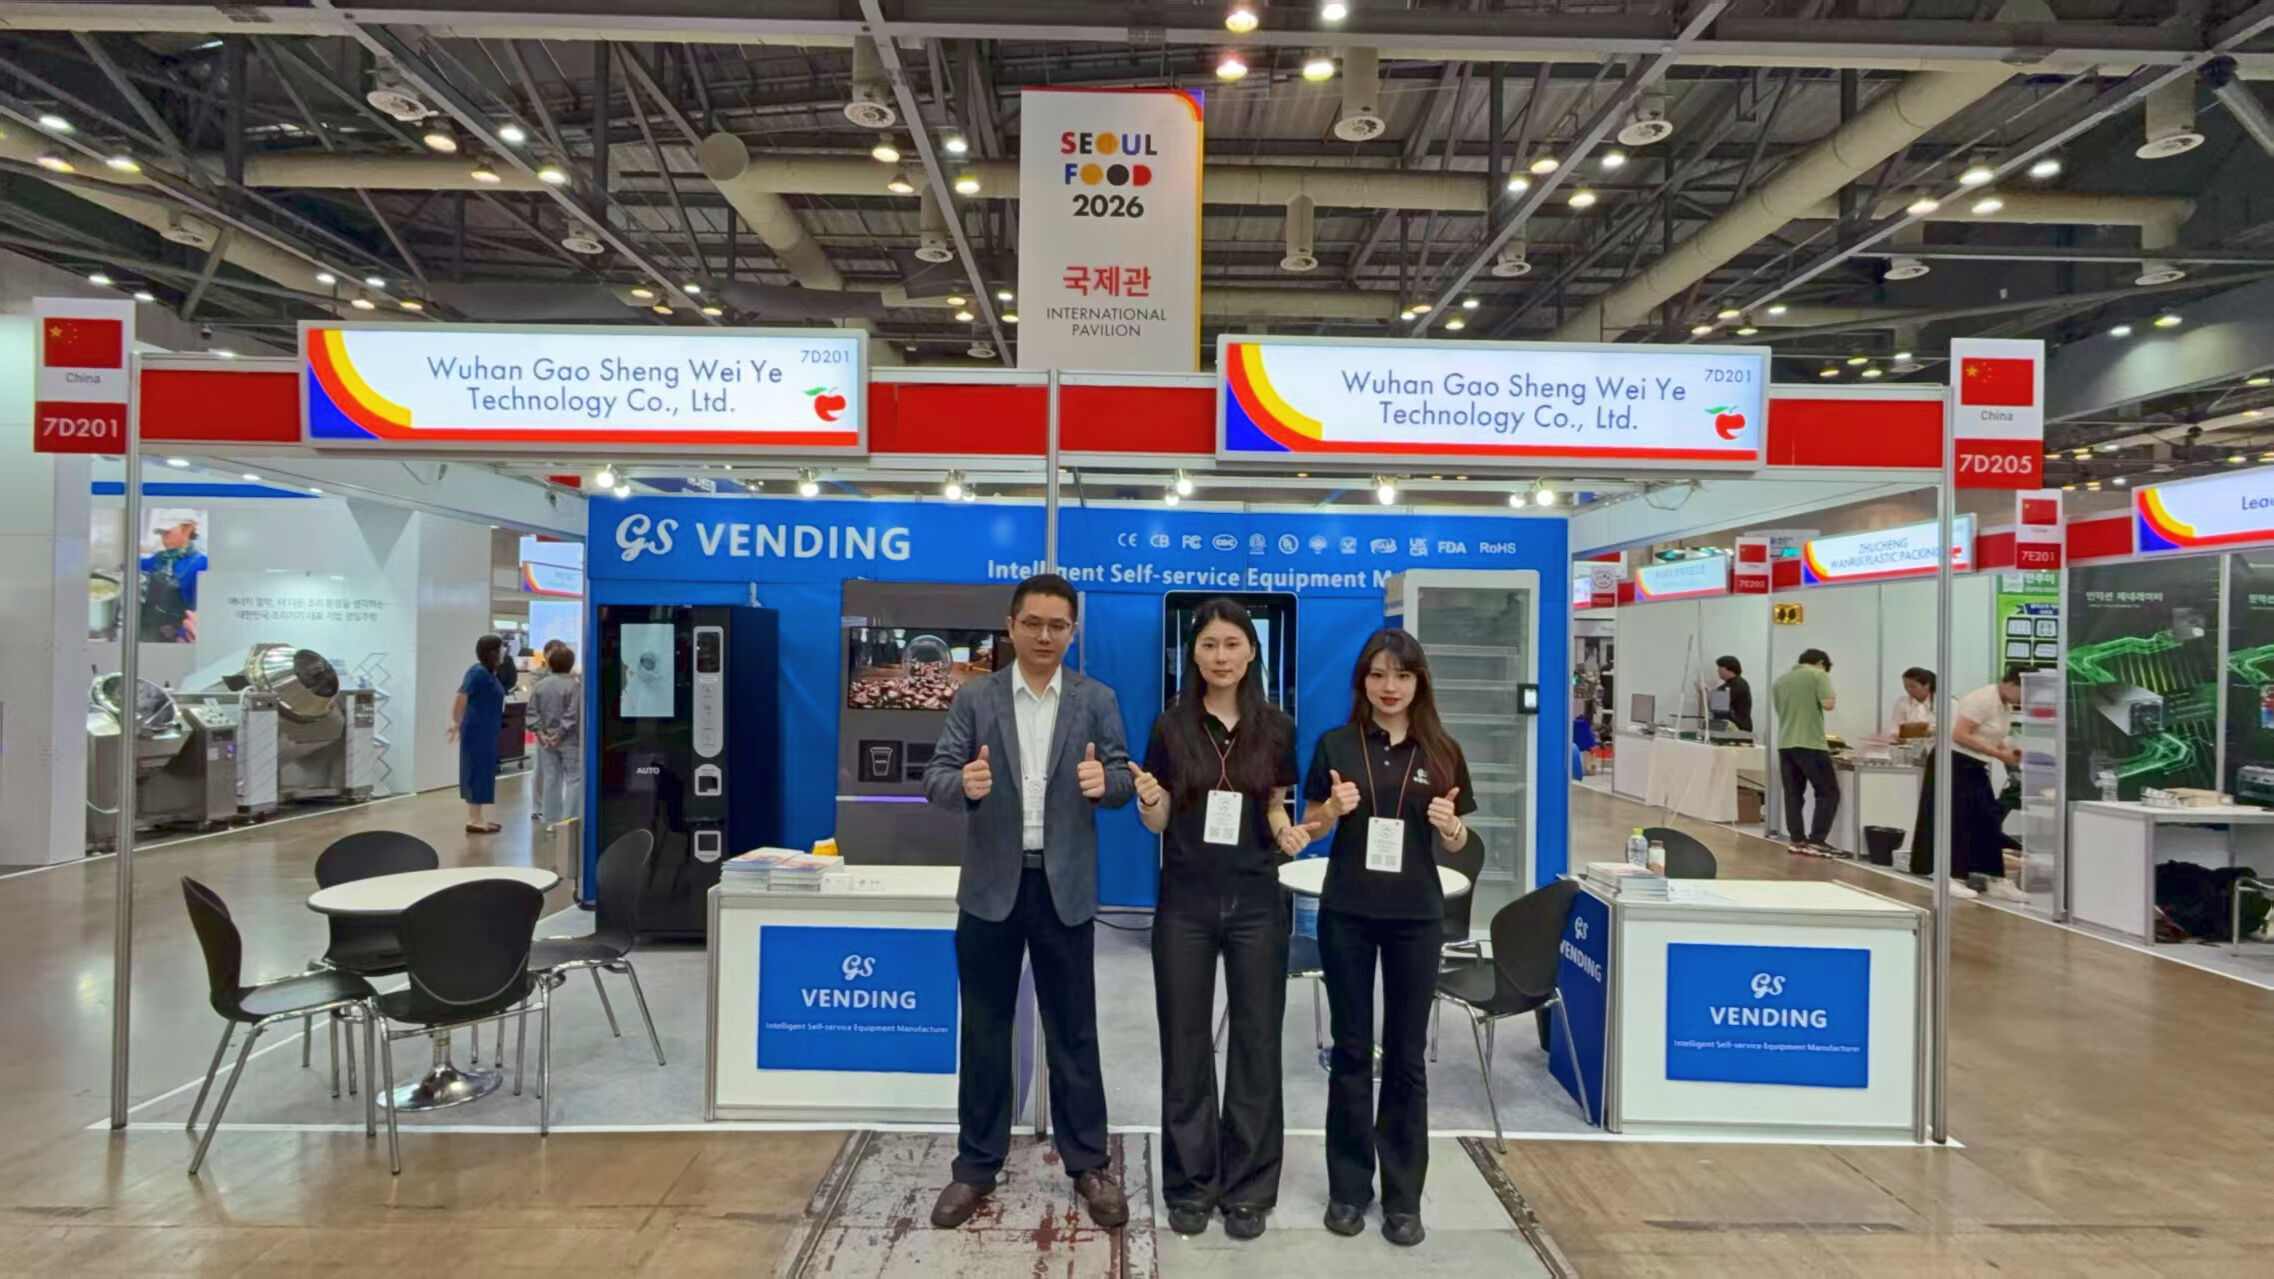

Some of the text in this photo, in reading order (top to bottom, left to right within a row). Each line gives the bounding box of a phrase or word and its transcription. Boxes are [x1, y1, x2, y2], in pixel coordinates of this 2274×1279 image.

[1060, 132, 1158, 156] SEOUL
[1064, 163, 1152, 186] FOOD
[1072, 194, 1144, 218] 2026
[1062, 266, 1151, 297] 국제관
[1046, 307, 1167, 321] INTERNATIONAL
[1071, 324, 1141, 337] PAVILION
[800, 349, 851, 364] 7D201
[64, 372, 102, 384] China
[426, 356, 783, 387] Wuhan Gao Sheng Wei Ye
[1704, 368, 1753, 384] 7D201
[1341, 370, 1687, 405] Wuhan Gao Sheng Wei Ye
[467, 387, 737, 417] Technology Co., Ltd.
[1378, 402, 1639, 433] Technology Co., Ltd.
[1980, 410, 2014, 422] China
[42, 417, 118, 439] 7D201
[1959, 454, 2033, 474] 7D205
[615, 513, 911, 562] GS VENDING
[1117, 532, 1138, 548] CE
[1437, 540, 1468, 555] FDA
[1479, 542, 1516, 555] RoHS
[1110, 564, 1240, 588] Self-service
[1247, 567, 1366, 593] Equipment
[635, 767, 661, 775] AUTO
[841, 954, 876, 981] GS
[1750, 972, 1787, 1000] GS
[801, 988, 917, 1010] VENDING
[765, 1021, 949, 1034] Intelligent Self-service Equipment Manufacturer
[1709, 1006, 1828, 1029] VENDING
[1673, 1039, 1715, 1050] Intelligent
[1763, 1041, 1806, 1052] Equipment
